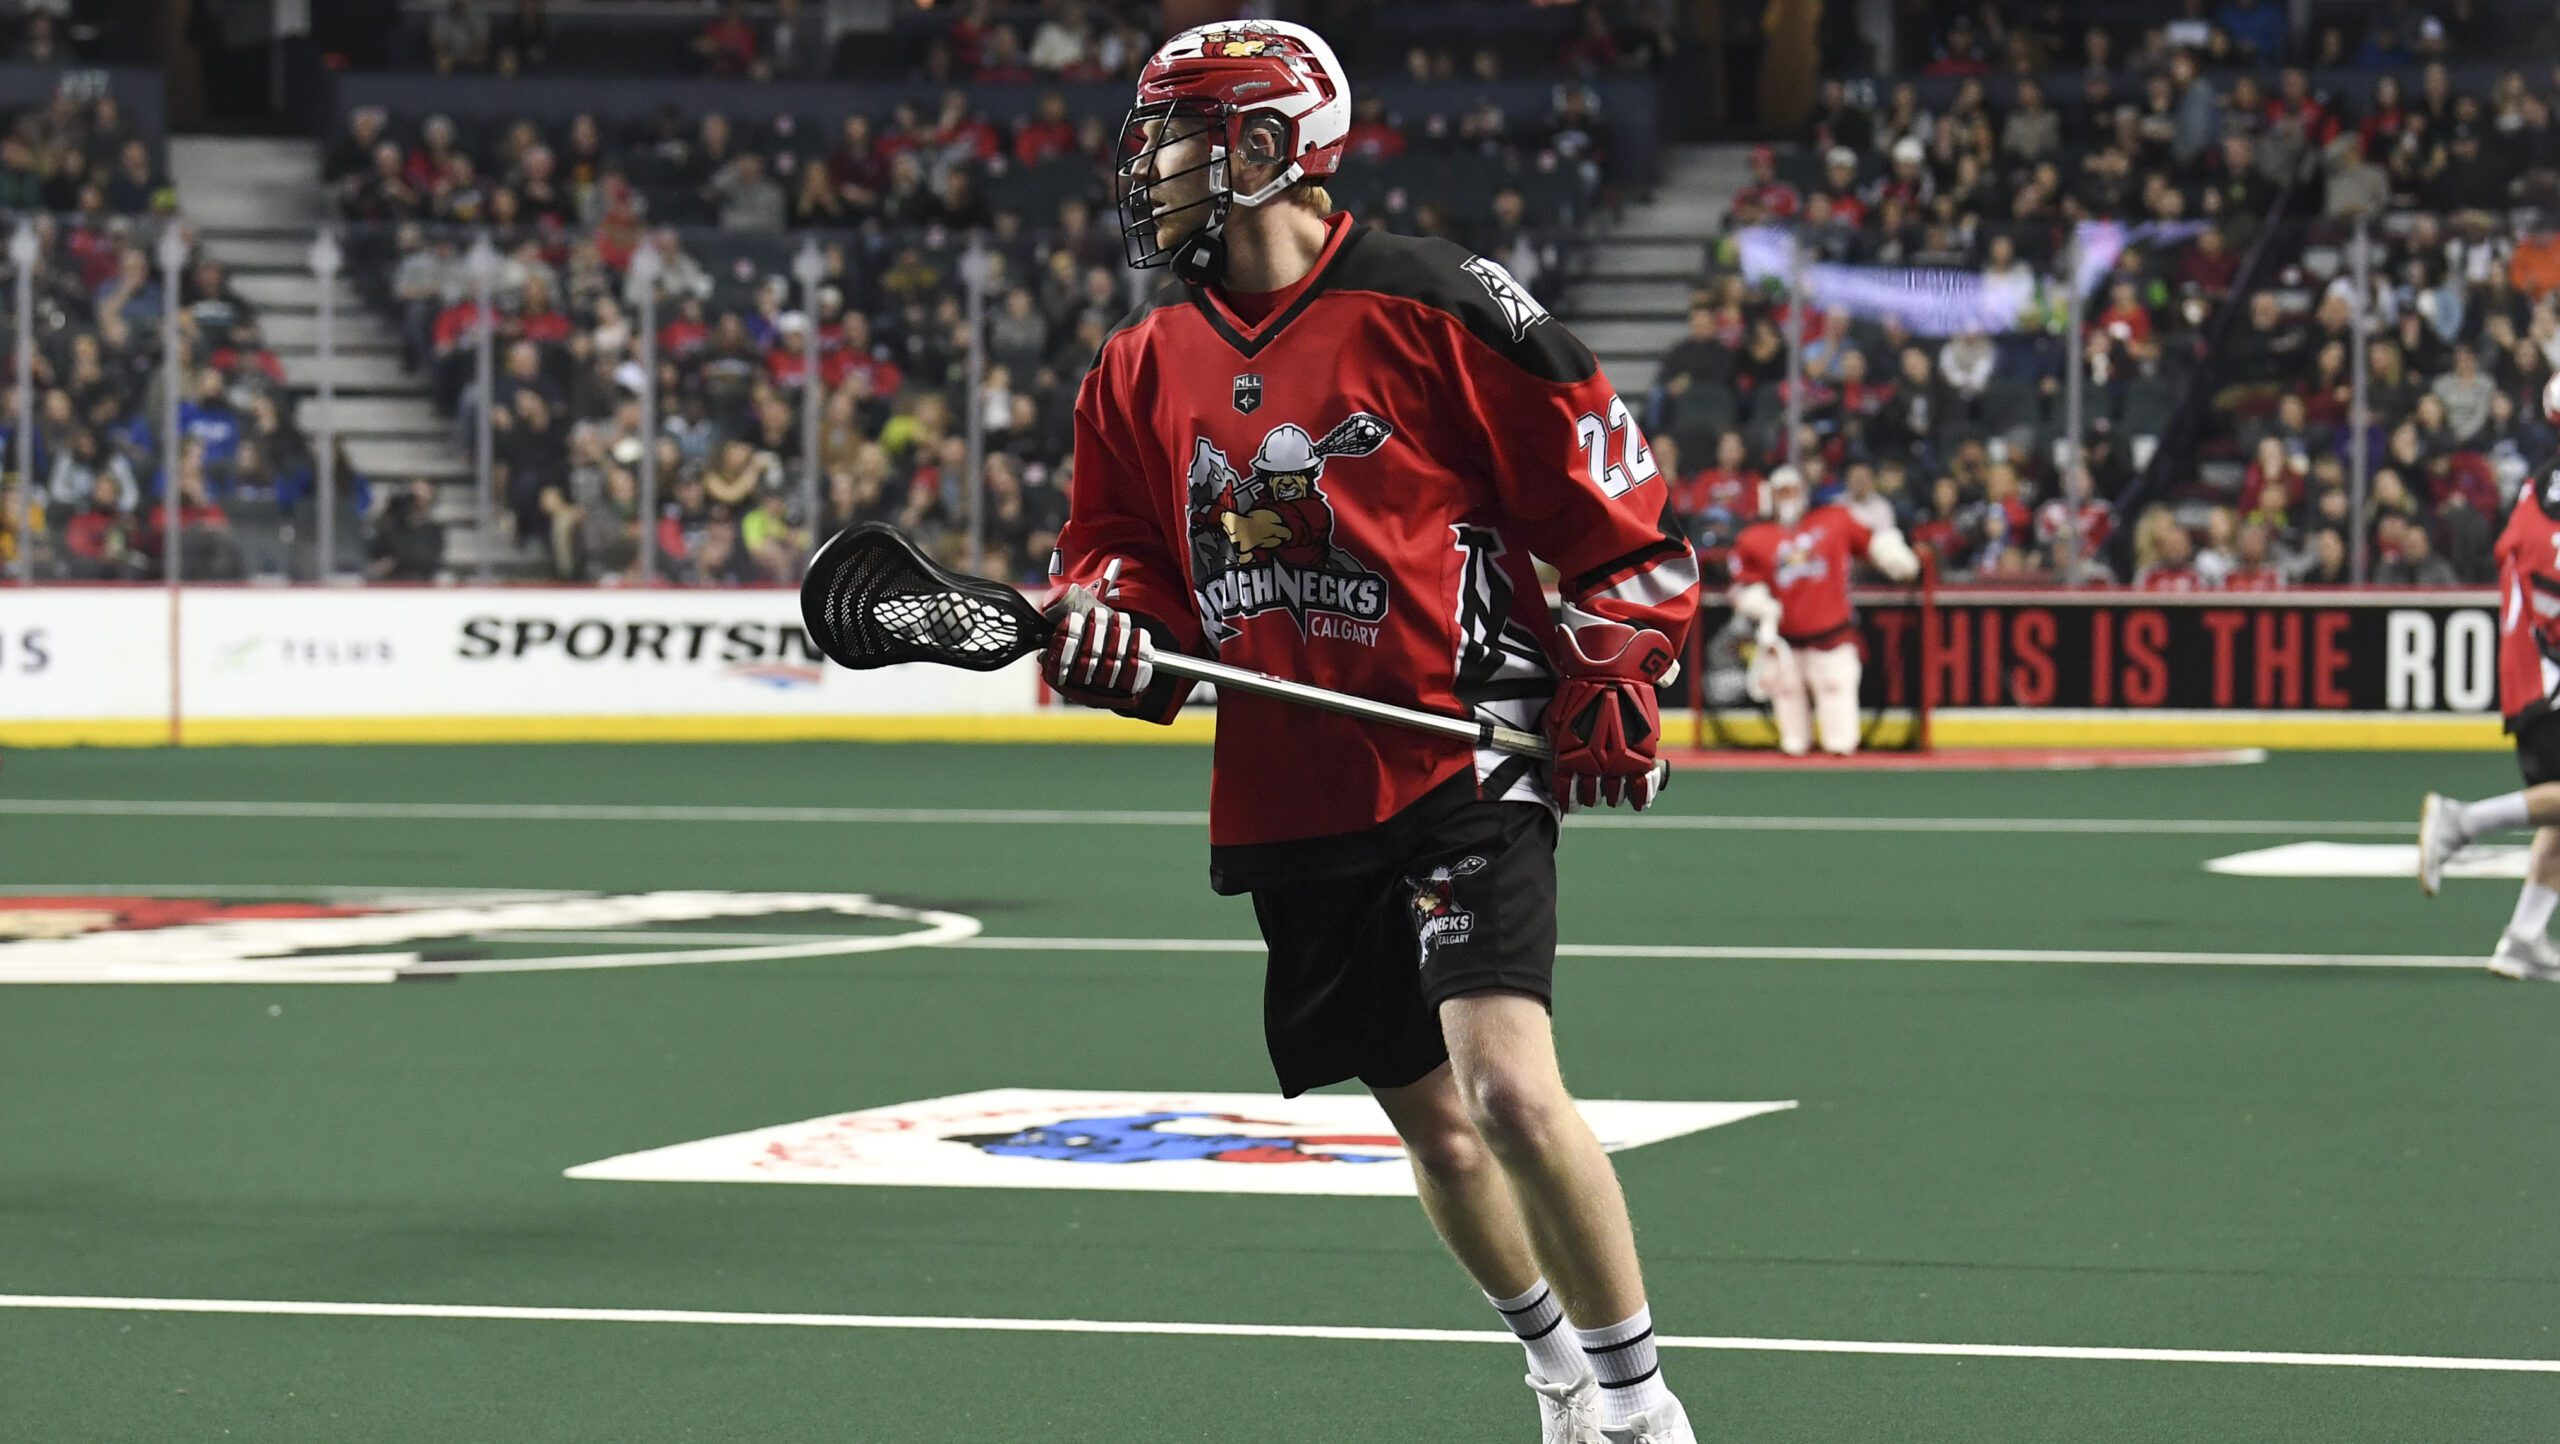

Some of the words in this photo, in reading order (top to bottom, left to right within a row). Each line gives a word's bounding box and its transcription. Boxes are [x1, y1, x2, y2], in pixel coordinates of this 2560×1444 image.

[1236, 377, 1260, 387] NLL
[1577, 395, 1658, 499] 22
[1311, 616, 1379, 647] CALGARY
[1872, 609, 2057, 706] THIS
[2091, 609, 2168, 706] IS
[2203, 611, 2351, 707] THE
[2386, 611, 2494, 710] RO
[1438, 934, 1470, 945] CALGARY
